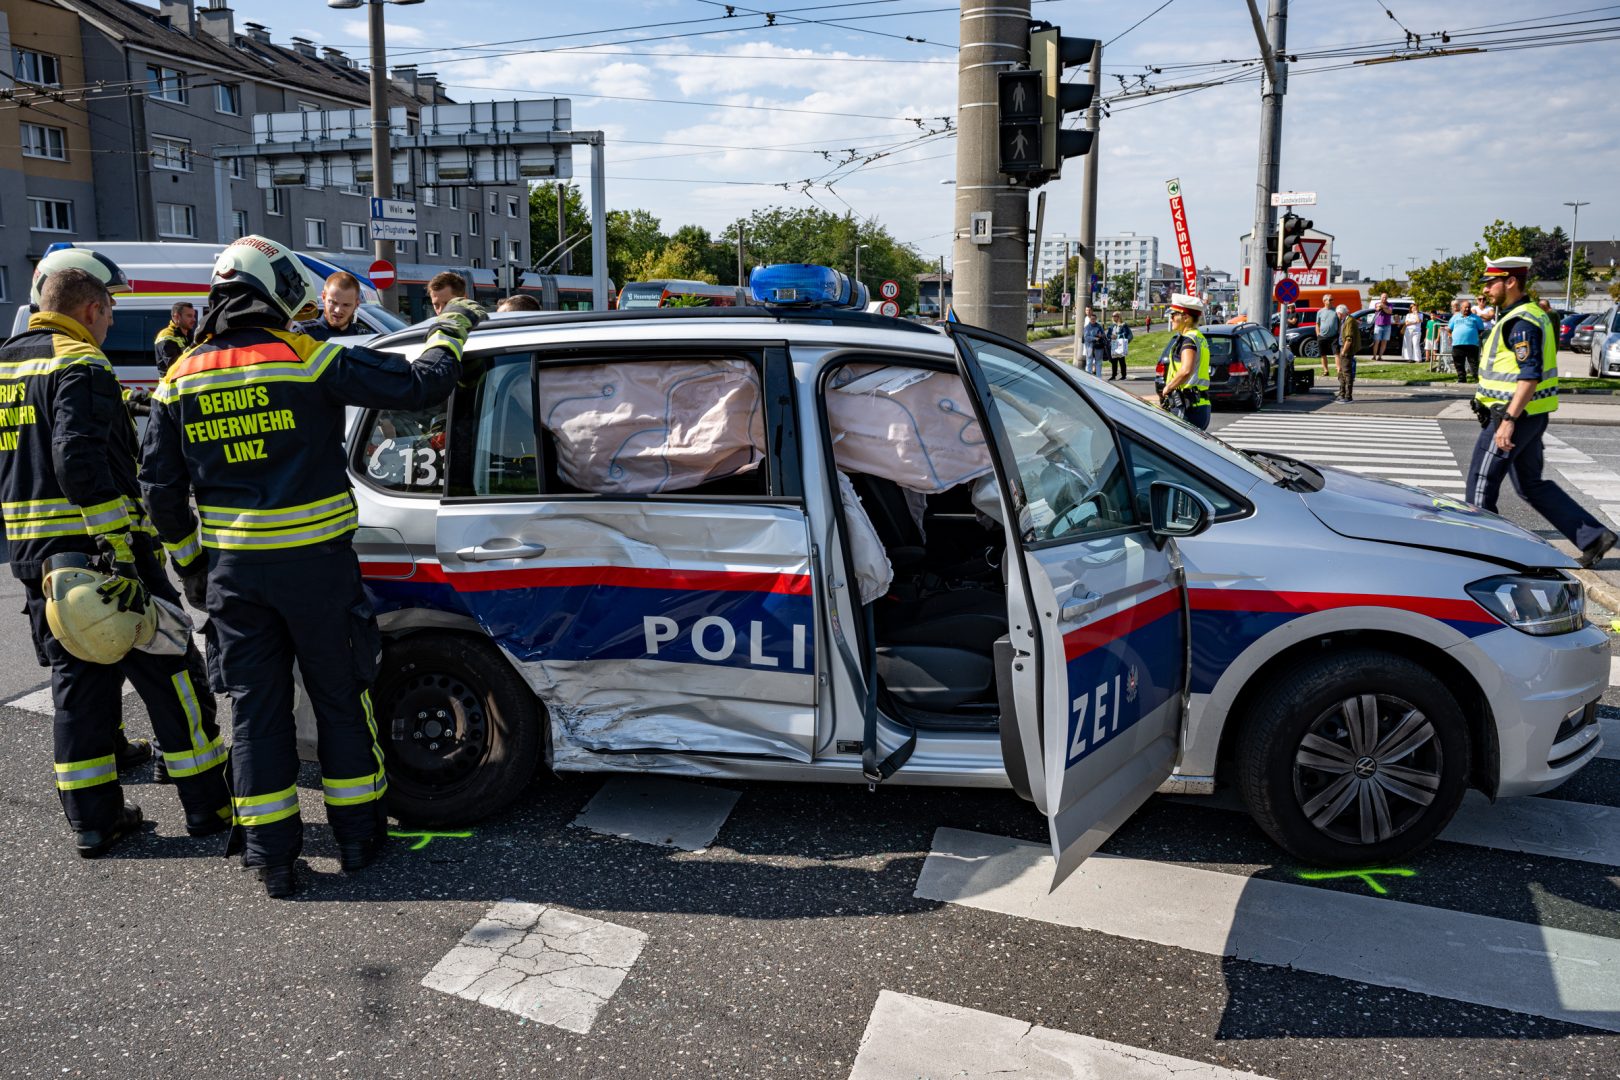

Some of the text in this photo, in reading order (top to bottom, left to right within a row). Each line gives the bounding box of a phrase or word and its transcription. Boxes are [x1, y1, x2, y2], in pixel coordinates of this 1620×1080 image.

[374, 200, 403, 217] 1 Wels
[1171, 197, 1196, 296] INTERSPAR
[885, 285, 895, 295] 70
[198, 385, 270, 416] BERUFS
[184, 409, 296, 443] FEUERWEHR
[223, 438, 268, 464] LINZ
[643, 615, 806, 669] POLI
[1069, 674, 1121, 761] ZEI
